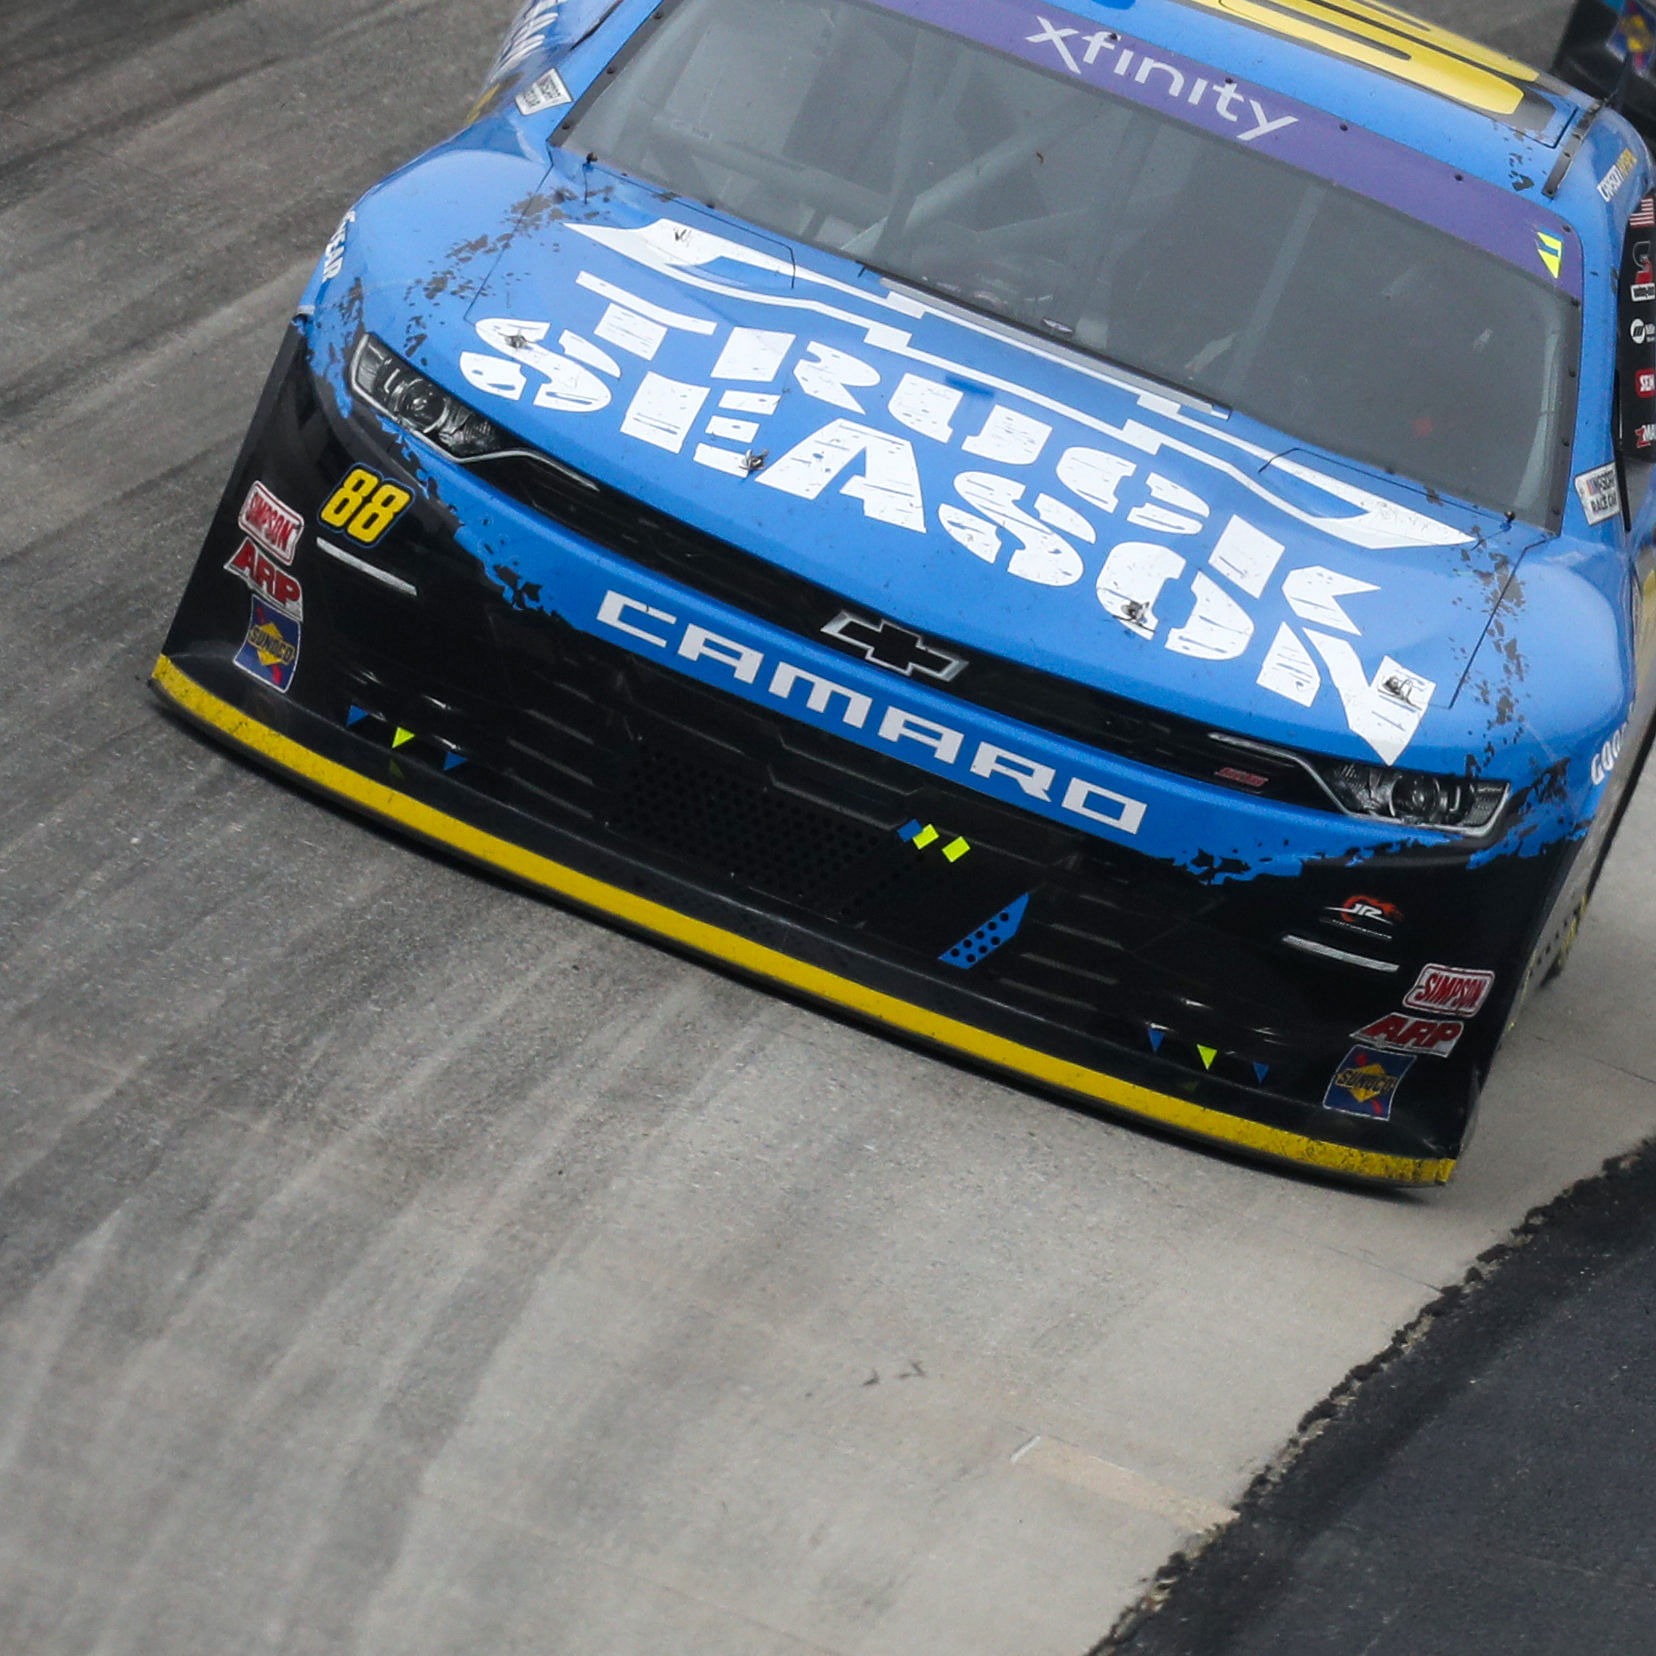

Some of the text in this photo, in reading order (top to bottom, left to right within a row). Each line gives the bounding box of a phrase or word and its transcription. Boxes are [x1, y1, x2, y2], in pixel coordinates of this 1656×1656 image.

[1026, 15, 1299, 143] xfinity
[577, 269, 1381, 637] TRUCK
[245, 491, 295, 556] SIMPSON
[320, 468, 411, 544] 88
[232, 540, 301, 607] ARP
[459, 316, 1438, 768] SEASON
[248, 624, 296, 666] SUNOCO
[595, 589, 1148, 835] CAMARO
[1416, 971, 1488, 1012] SIMPSON
[1362, 1014, 1463, 1048] ARP
[1336, 1068, 1399, 1094] SUNOCO
